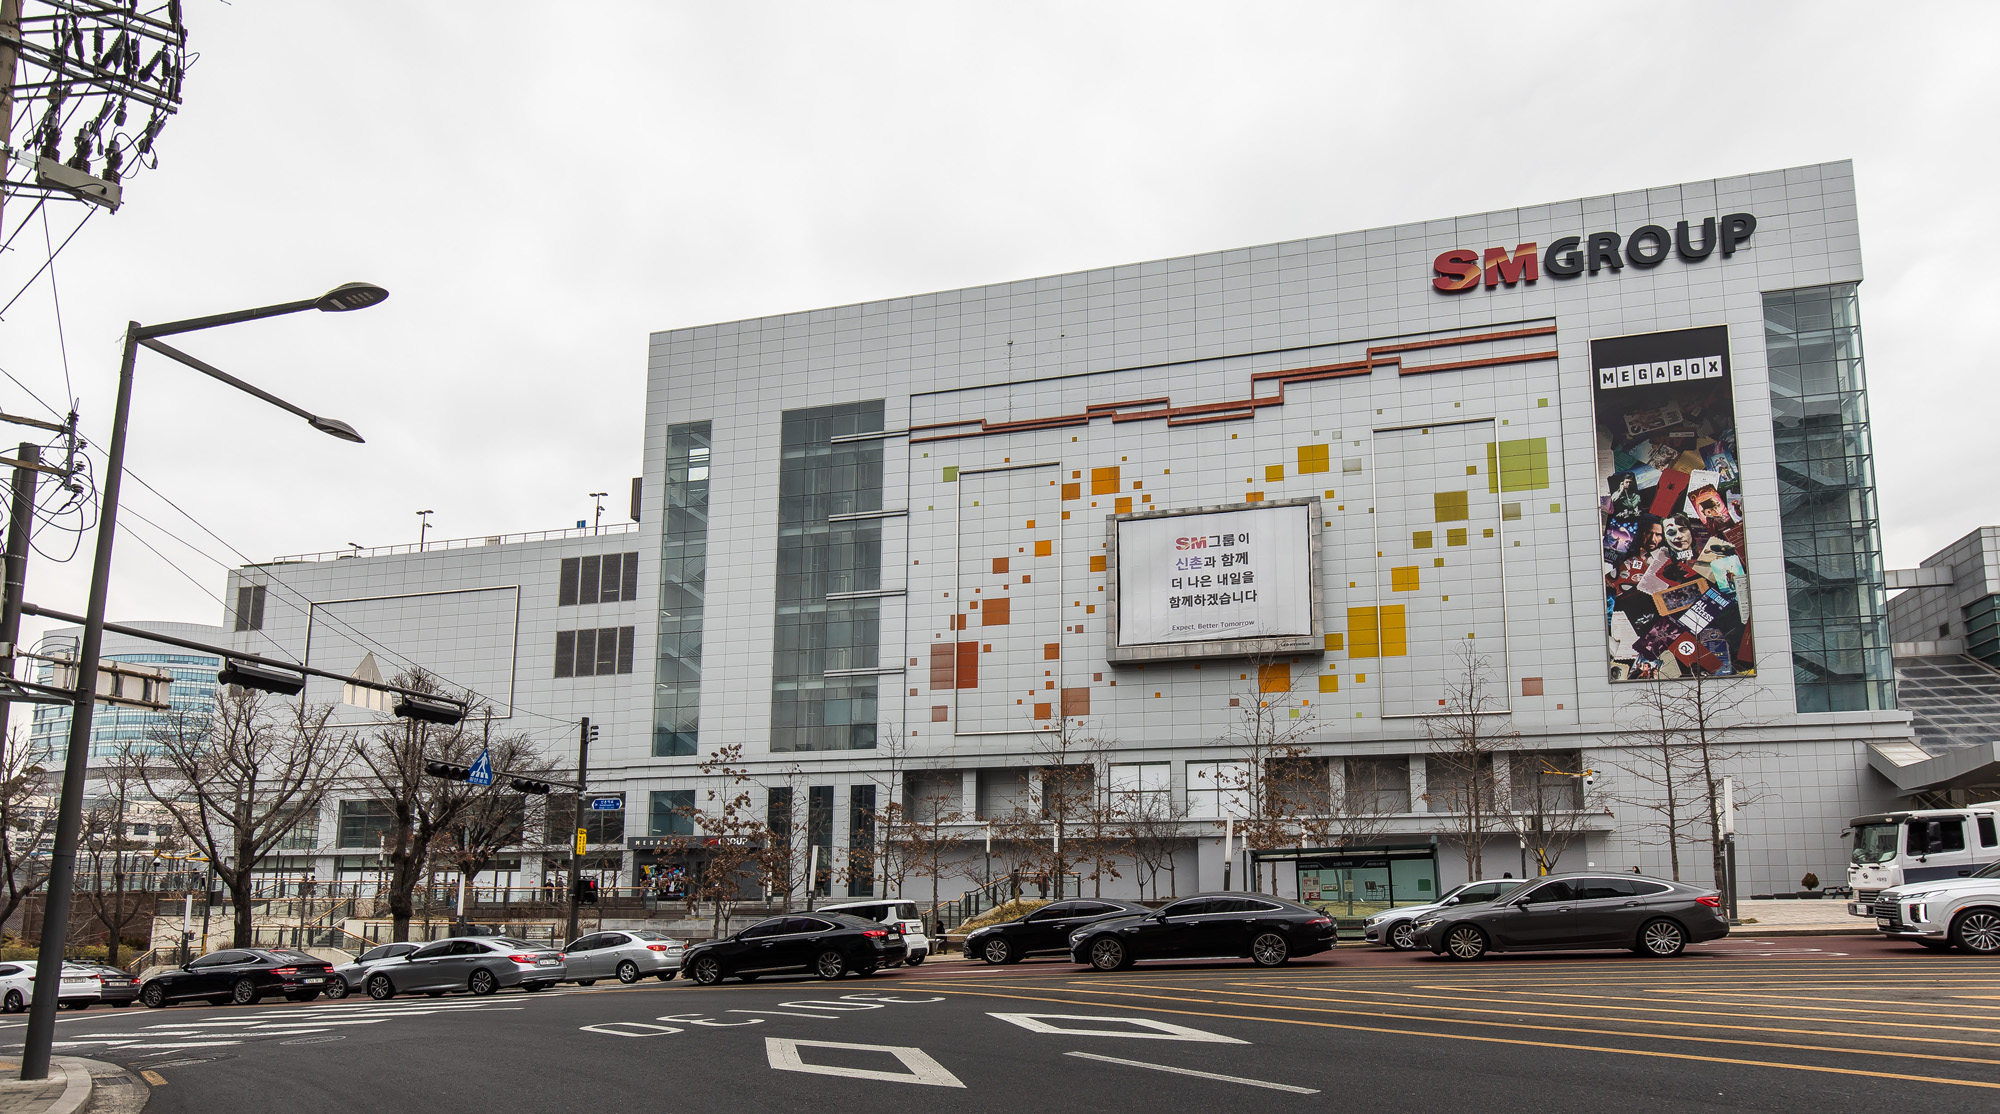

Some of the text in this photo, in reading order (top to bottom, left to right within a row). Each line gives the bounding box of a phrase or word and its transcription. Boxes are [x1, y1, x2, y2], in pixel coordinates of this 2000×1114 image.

[1602, 361, 1718, 384] MEGABOX
[1176, 552, 1248, 571] 신촌과 함께
[1171, 571, 1254, 589] 더 나은 내일을
[1169, 590, 1257, 608] 함께하겠습니다
[1695, 600, 1707, 610] ALL
[1691, 604, 1714, 622] ACCESS
[1221, 620, 1255, 628] Tomorrow
